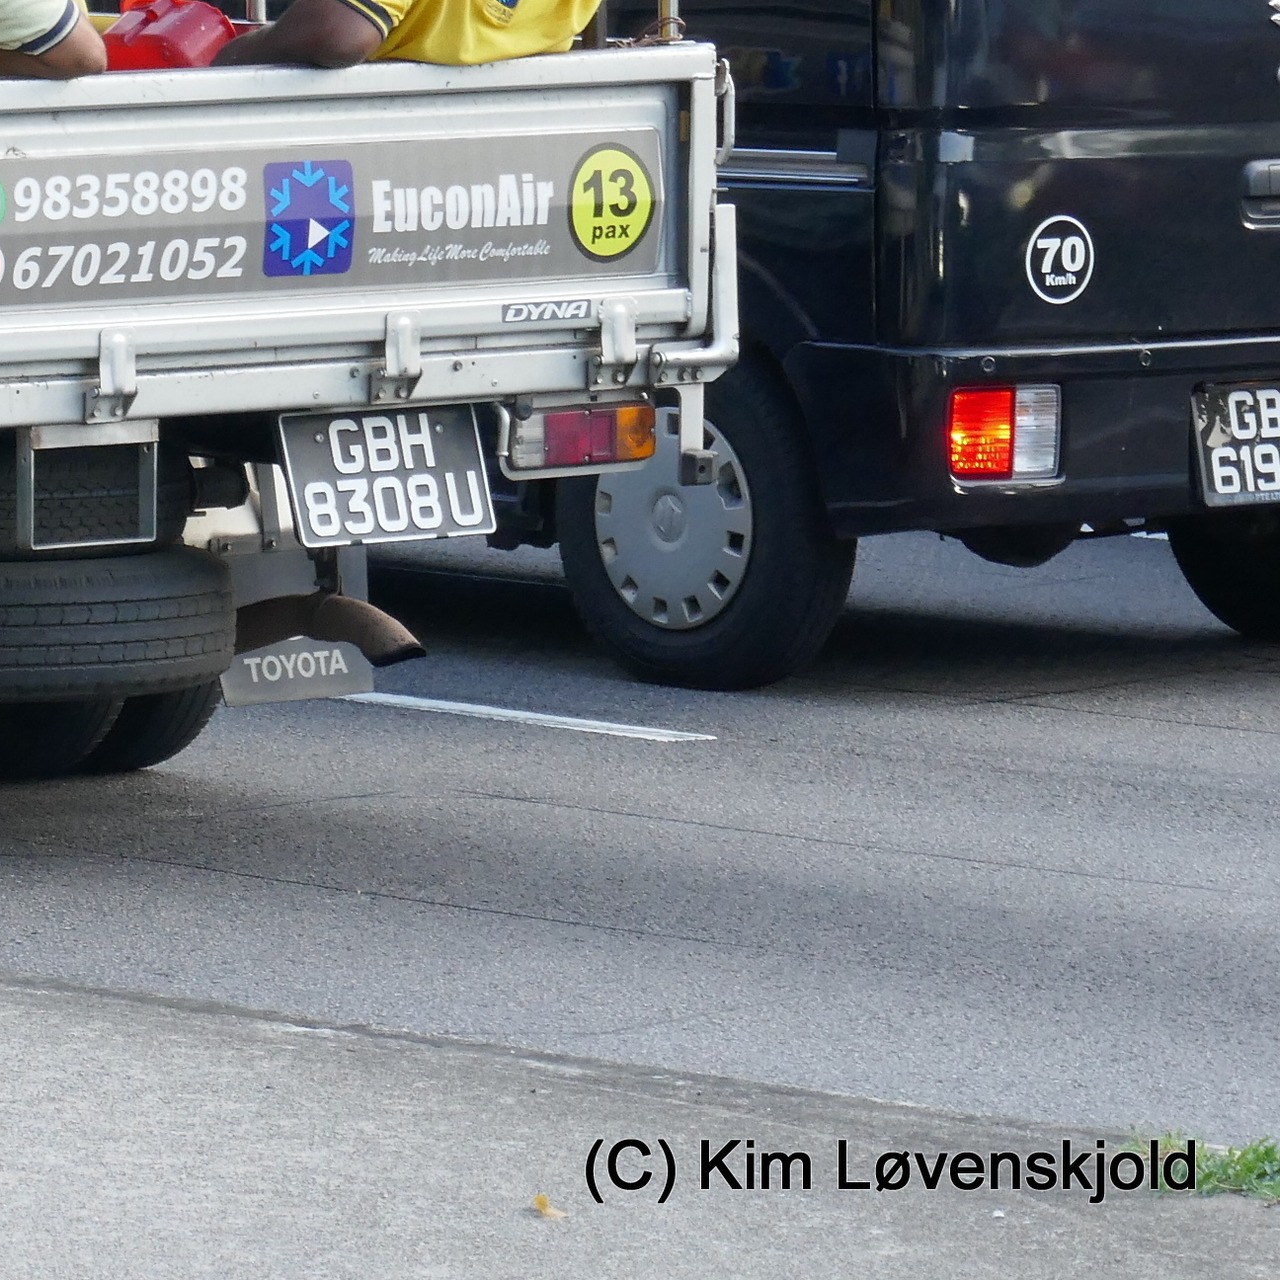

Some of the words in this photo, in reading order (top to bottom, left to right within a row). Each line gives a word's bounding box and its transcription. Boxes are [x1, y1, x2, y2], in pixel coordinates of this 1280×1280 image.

[12, 166, 248, 222] 98358898
[371, 173, 554, 234] EuconAir
[582, 168, 638, 219] 13
[591, 222, 631, 245] pax
[12, 235, 248, 291] 67021052
[368, 247, 418, 267] Making
[417, 244, 445, 266] Life
[444, 243, 479, 261] More
[478, 239, 551, 262] Comfortable
[1036, 235, 1086, 273] 70
[1044, 273, 1077, 287] Km/h
[504, 300, 590, 322] DYNA
[328, 413, 435, 474] GBH
[243, 649, 349, 683] TOYOTA
